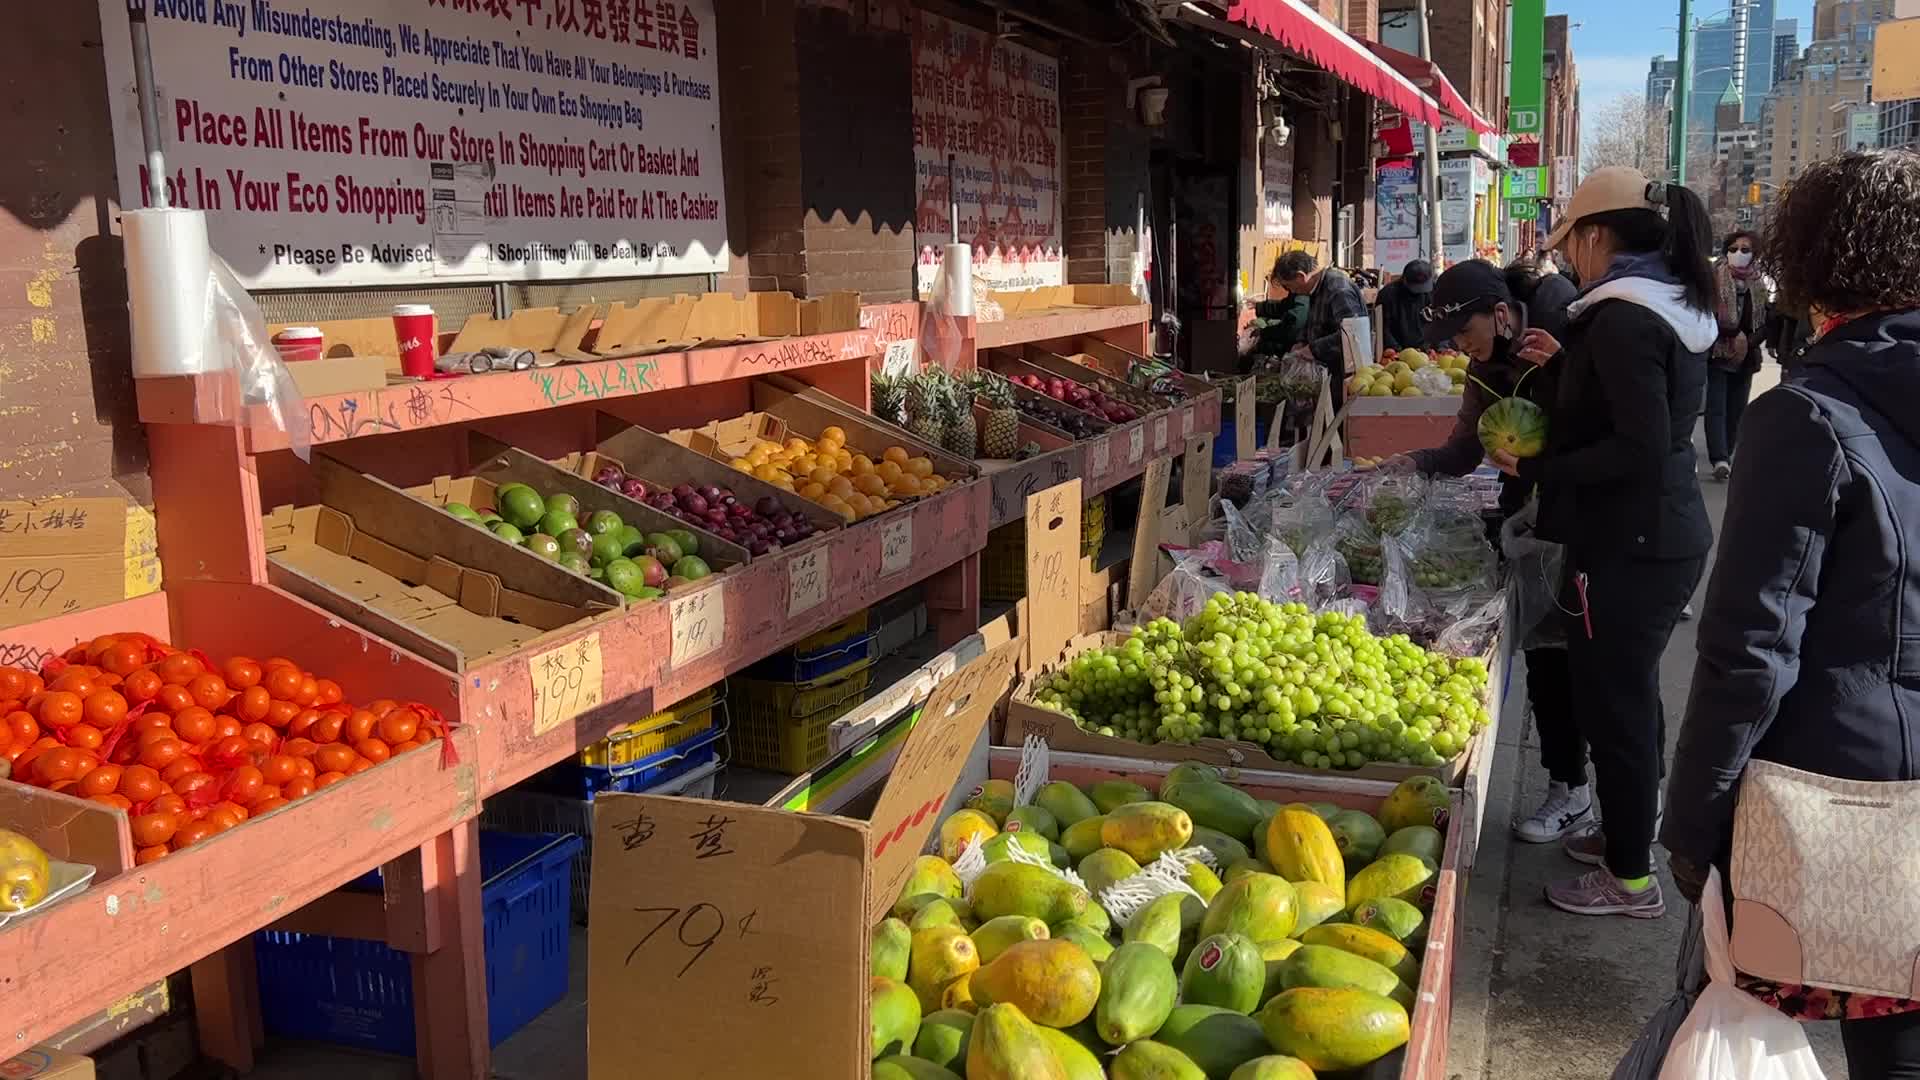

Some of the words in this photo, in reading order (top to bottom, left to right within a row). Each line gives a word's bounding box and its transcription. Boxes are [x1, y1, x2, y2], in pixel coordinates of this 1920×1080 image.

[213, 3, 246, 37] Any
[252, 2, 397, 57] Misunderstanding,
[399, 24, 421, 54] We
[424, 28, 491, 66] Appreciate
[492, 41, 519, 69] That
[521, 47, 545, 75] You
[547, 50, 573, 78] Have
[574, 55, 587, 81] All
[588, 57, 610, 83] Your
[611, 62, 662, 97] Belongings
[663, 71, 671, 91] &
[672, 73, 711, 101] Purchases
[229, 46, 274, 82] From
[279, 53, 325, 89] Other
[329, 59, 379, 95] Stores
[383, 66, 429, 99] Placed
[431, 73, 486, 113] Securely
[488, 81, 501, 107] In
[502, 83, 529, 112] Your
[531, 88, 557, 114] Own
[559, 91, 578, 117] Eco
[580, 94, 623, 129] Shopping
[624, 101, 643, 130] Bag
[175, 98, 248, 147] Place
[253, 106, 284, 149] All
[290, 110, 352, 155] Items
[358, 117, 408, 159] From
[413, 122, 445, 161] Our
[449, 126, 495, 164] Store
[499, 131, 515, 165] In
[519, 132, 586, 178] Shopping
[588, 139, 616, 173] Cart
[620, 142, 635, 172] Or
[637, 143, 678, 176] Basket
[679, 149, 700, 177] And
[1511, 111, 1537, 129] TD
[1439, 160, 1469, 169] TIGER
[195, 167, 221, 210] In
[226, 168, 280, 212] Your
[286, 172, 329, 213] Eco
[334, 174, 426, 225] Shopping
[483, 182, 509, 217] ntil
[512, 183, 556, 218] Items
[559, 186, 584, 219] Are
[586, 187, 615, 219] Paid
[618, 188, 638, 219] For
[641, 190, 655, 220] At
[657, 190, 678, 221] The
[680, 191, 719, 221] Cashier
[1511, 202, 1527, 215] TD
[273, 244, 336, 265] Please
[341, 244, 365, 264] Be
[370, 243, 433, 264] Advised
[498, 244, 567, 265] Shoplifting
[569, 245, 592, 261] Will
[594, 244, 609, 261] Be
[611, 243, 639, 260] Dealt
[640, 244, 653, 262] By
[655, 244, 678, 259] Law.
